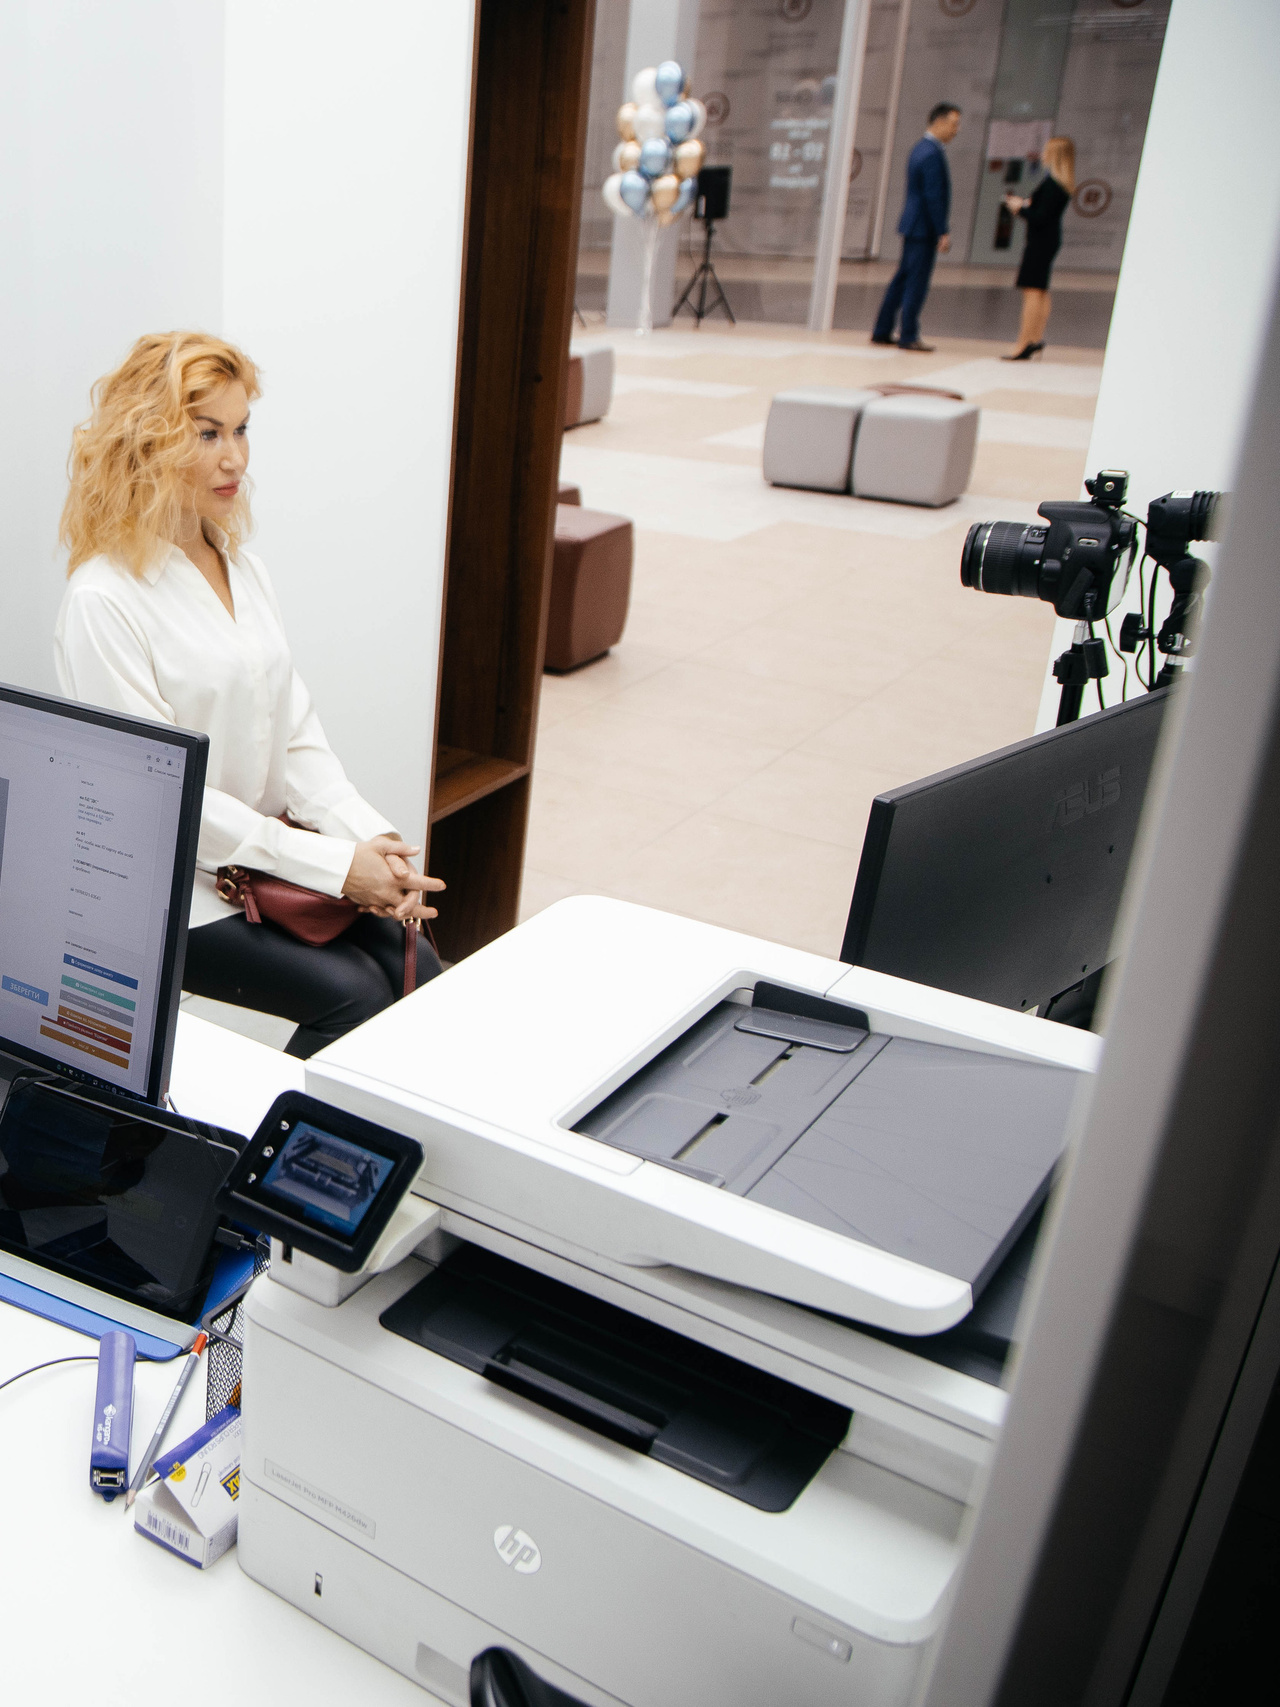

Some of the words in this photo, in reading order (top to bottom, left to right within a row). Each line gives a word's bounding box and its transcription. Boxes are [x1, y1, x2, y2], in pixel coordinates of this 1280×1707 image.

[10, 982, 40, 1000] ЗБЕРЕГТИ
[228, 1420, 242, 1437] APER
[215, 1431, 230, 1446] CLIPS
[197, 1442, 217, 1460] ROUND
[271, 1469, 302, 1491] LaserJet
[303, 1487, 317, 1499] Pro
[496, 1525, 539, 1573] hp
